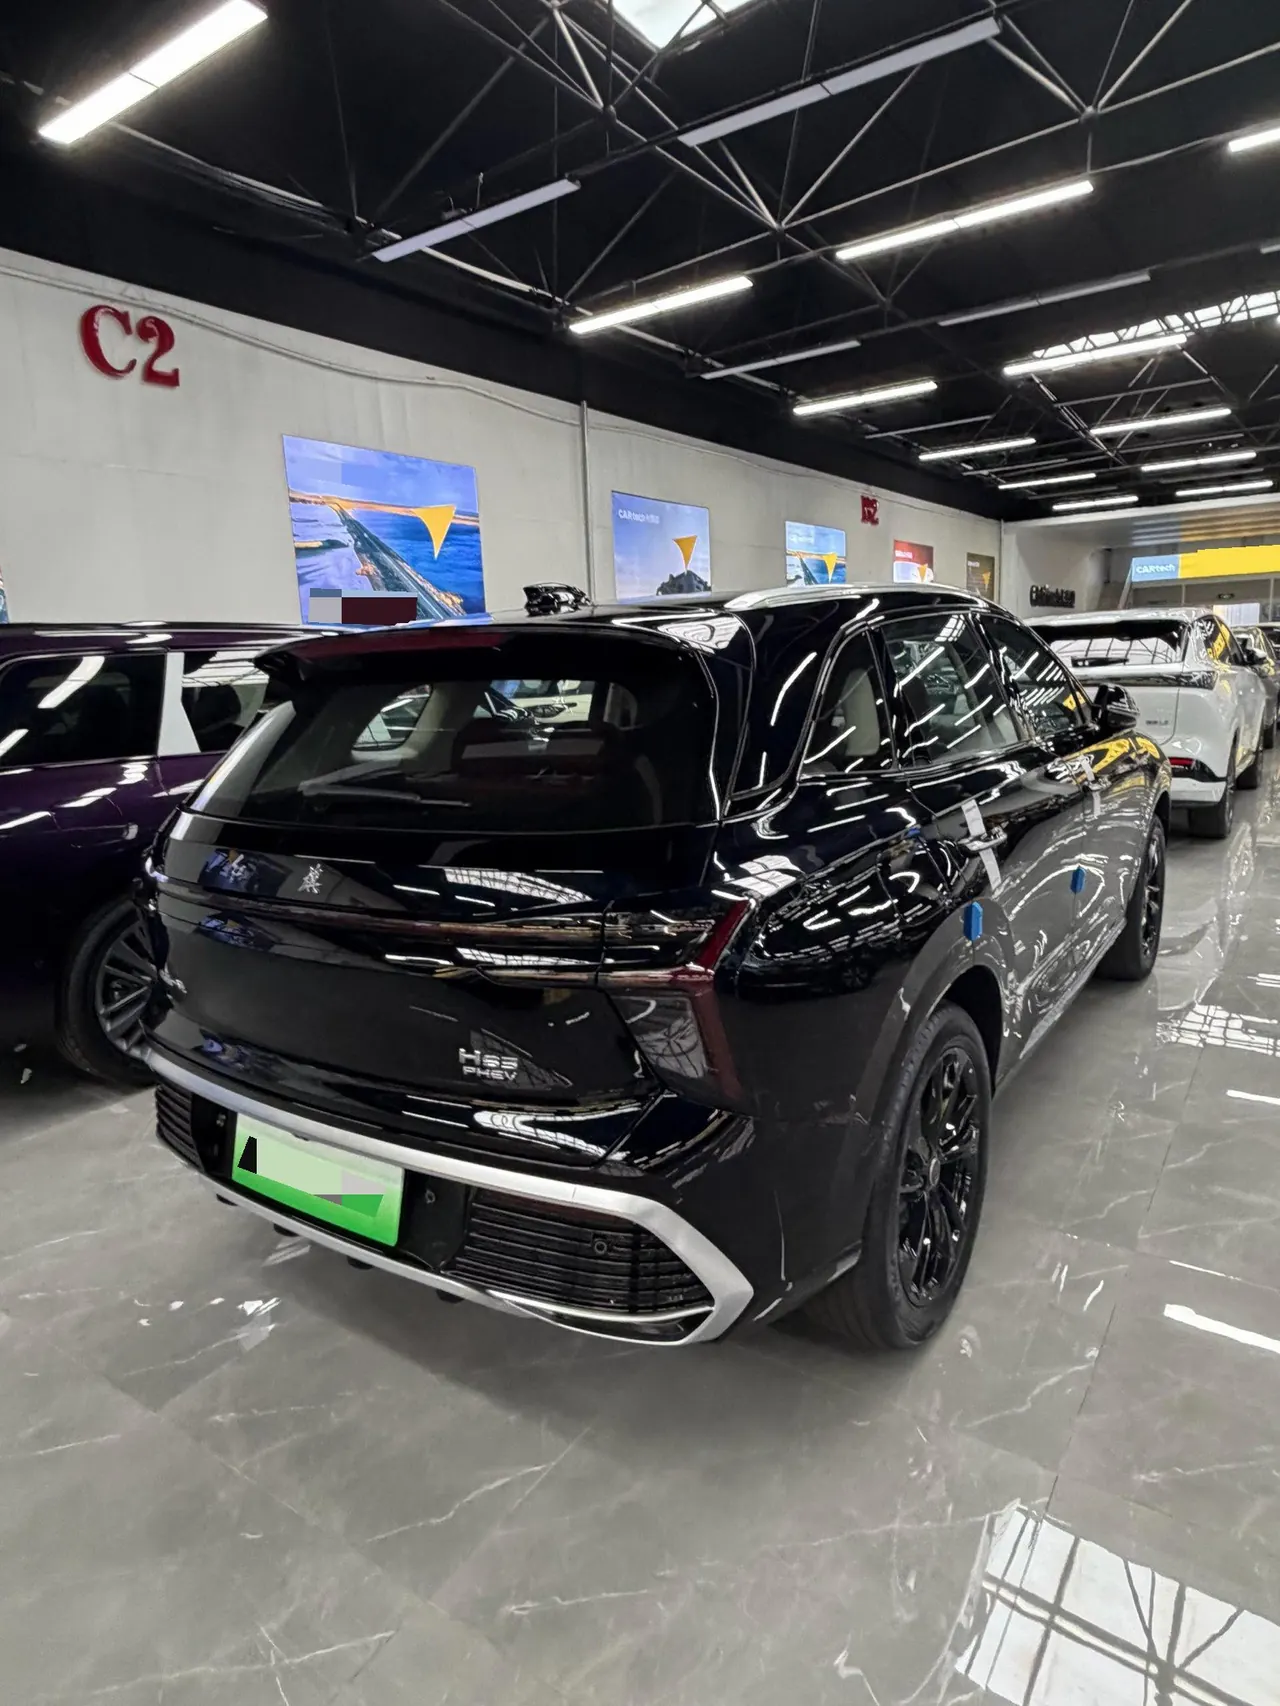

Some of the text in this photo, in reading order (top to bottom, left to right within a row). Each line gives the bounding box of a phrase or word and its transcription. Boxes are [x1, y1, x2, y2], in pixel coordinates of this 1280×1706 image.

[80, 304, 180, 387] C2
[1136, 563, 1176, 574] CARtech
[462, 1065, 518, 1081] PHEV
